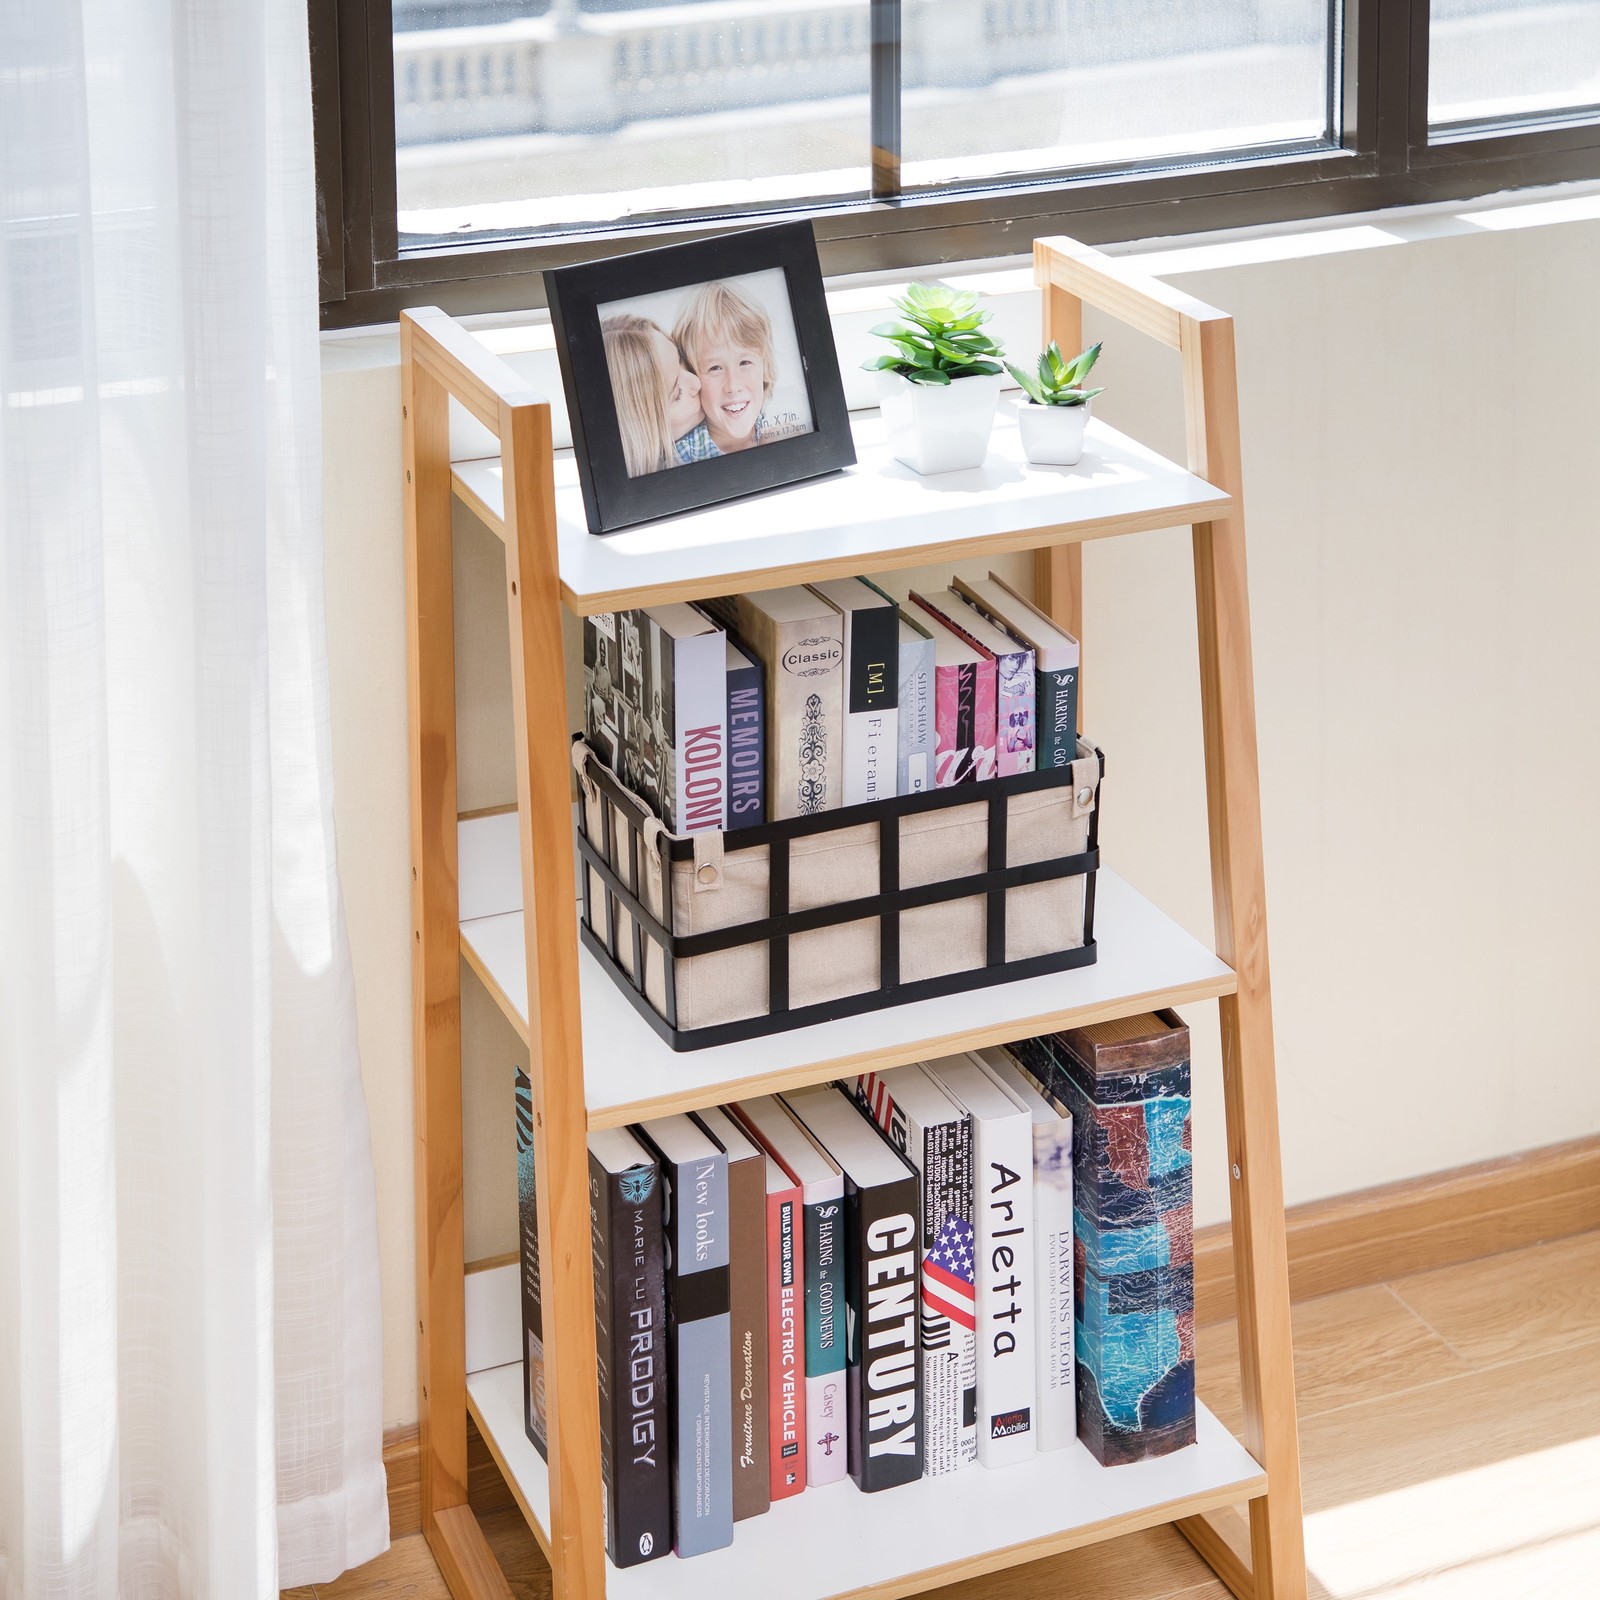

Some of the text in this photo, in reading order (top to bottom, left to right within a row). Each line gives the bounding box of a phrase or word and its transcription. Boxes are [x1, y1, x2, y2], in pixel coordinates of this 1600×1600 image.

[773, 414, 781, 426] X
[783, 411, 800, 423] 7in.
[781, 423, 807, 436] 17.7cm
[788, 649, 840, 666] Classic
[917, 672, 927, 745] SIDESHOW
[684, 724, 722, 831] KOLONI
[730, 687, 761, 814] MEMOIRS
[866, 718, 882, 802] Fierami
[695, 1162, 715, 1262] New looks
[947, 1188, 955, 1212] meglio
[956, 1175, 962, 1184] 31
[634, 1209, 646, 1300] MARIE LU
[782, 1205, 792, 1284] BUILD YOUR OWN
[990, 1161, 1025, 1359] Arletta
[819, 1282, 833, 1315] GOOD
[819, 1316, 834, 1349] NEWS
[1059, 1230, 1071, 1387] DARWINS TEORI
[740, 1330, 753, 1401] Decoration
[781, 1287, 796, 1441] ELECTRIC VEHICLE
[866, 1212, 917, 1458] CENTURY
[947, 1352, 959, 1363] A
[630, 1306, 656, 1468] PRODIGY
[820, 1383, 837, 1419] Casey
[960, 1436, 975, 1448] 2000
[992, 1421, 1029, 1438] Mobilier
